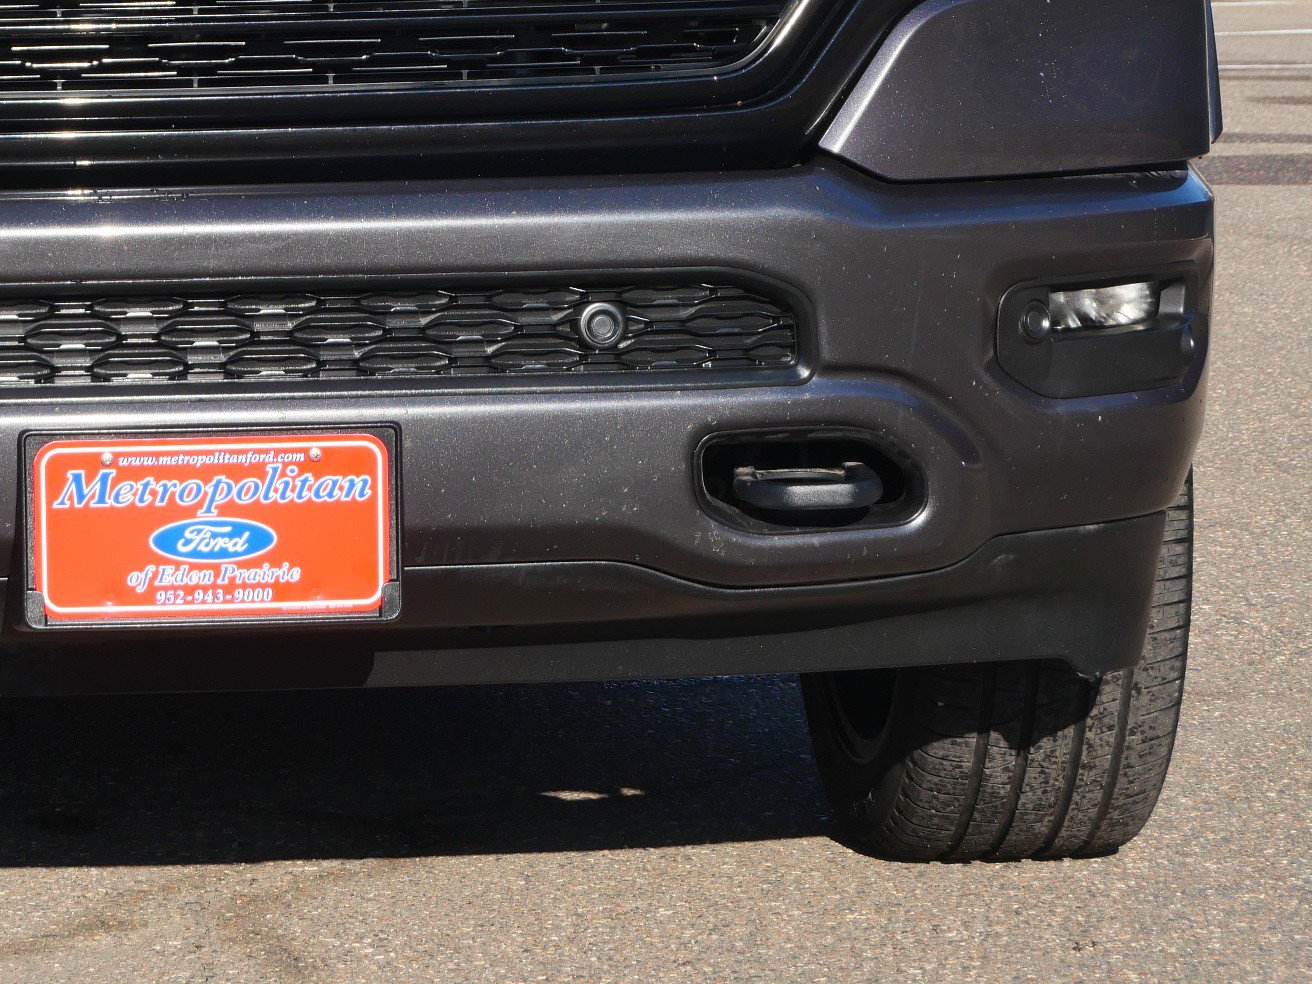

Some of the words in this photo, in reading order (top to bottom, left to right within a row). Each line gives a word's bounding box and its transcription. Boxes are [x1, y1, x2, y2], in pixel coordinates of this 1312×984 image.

[118, 451, 305, 467] www.metropolitanford.com
[52, 464, 373, 516] Metropolitan
[176, 524, 249, 553] Ford
[127, 565, 156, 592] of
[154, 565, 214, 586] Eden
[217, 562, 301, 585] Prairie
[156, 588, 273, 604] 952-943-9000
